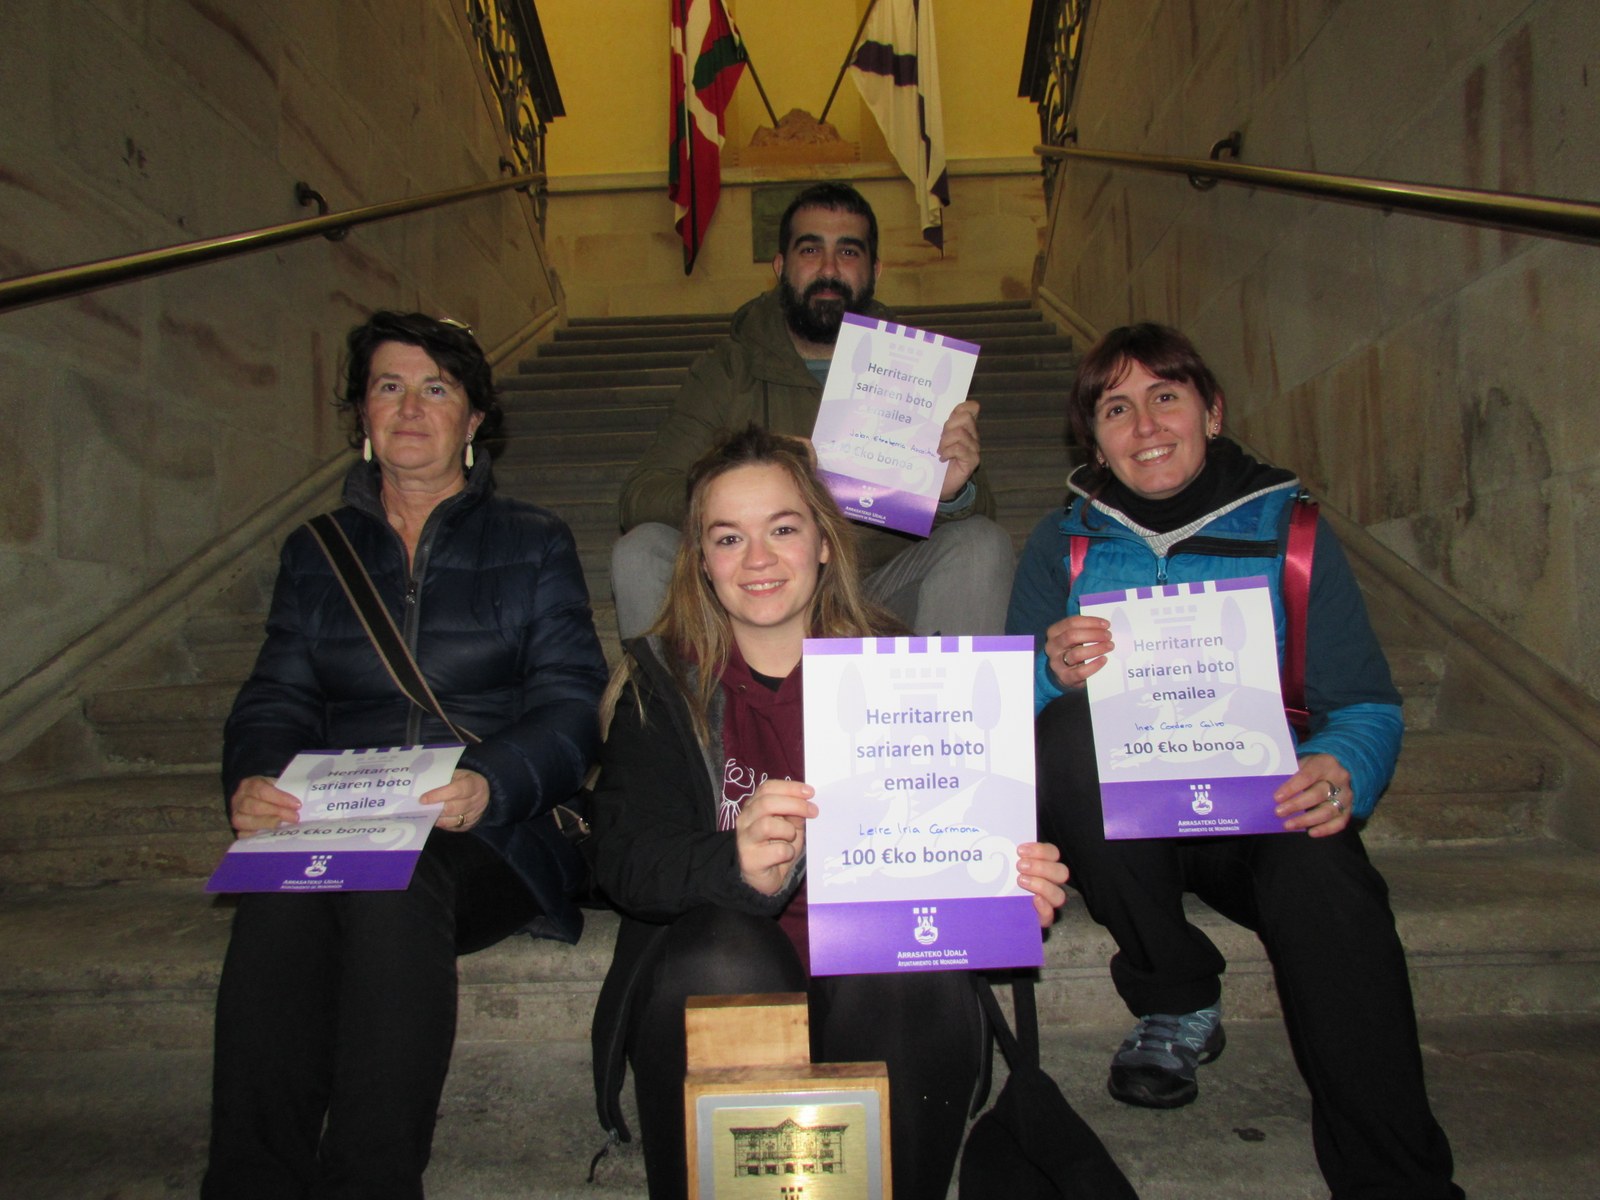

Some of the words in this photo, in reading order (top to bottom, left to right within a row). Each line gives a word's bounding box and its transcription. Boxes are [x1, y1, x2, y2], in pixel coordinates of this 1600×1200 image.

[867, 362, 932, 387] Herritarren
[856, 382, 903, 401] sariaren
[906, 393, 933, 409] boto
[877, 453, 913, 470] bonoa
[1134, 635, 1223, 652] Herritarren
[1127, 664, 1192, 678] sariaren
[1197, 660, 1235, 674] boto
[1152, 686, 1216, 701] emailea
[866, 707, 973, 724] Herritarren
[856, 741, 934, 758] sariaren
[940, 739, 985, 756] boto
[1123, 742, 1153, 755] 100
[1158, 740, 1188, 753] €ko
[1192, 739, 1245, 752] bonoa
[327, 766, 410, 777] Herritarren
[311, 780, 372, 791] sariaren
[376, 777, 412, 788] boto
[884, 772, 959, 790] emailea
[326, 798, 386, 811] emailea
[270, 829, 300, 837] 100
[336, 826, 387, 834] bonoa
[859, 823, 892, 836] Leire
[929, 823, 980, 835] Carmona
[841, 849, 876, 865] 100
[881, 847, 916, 864] €ko
[923, 846, 982, 863] bonoa
[897, 951, 942, 959] ARRASATEKO
[943, 949, 968, 957] UDALA
